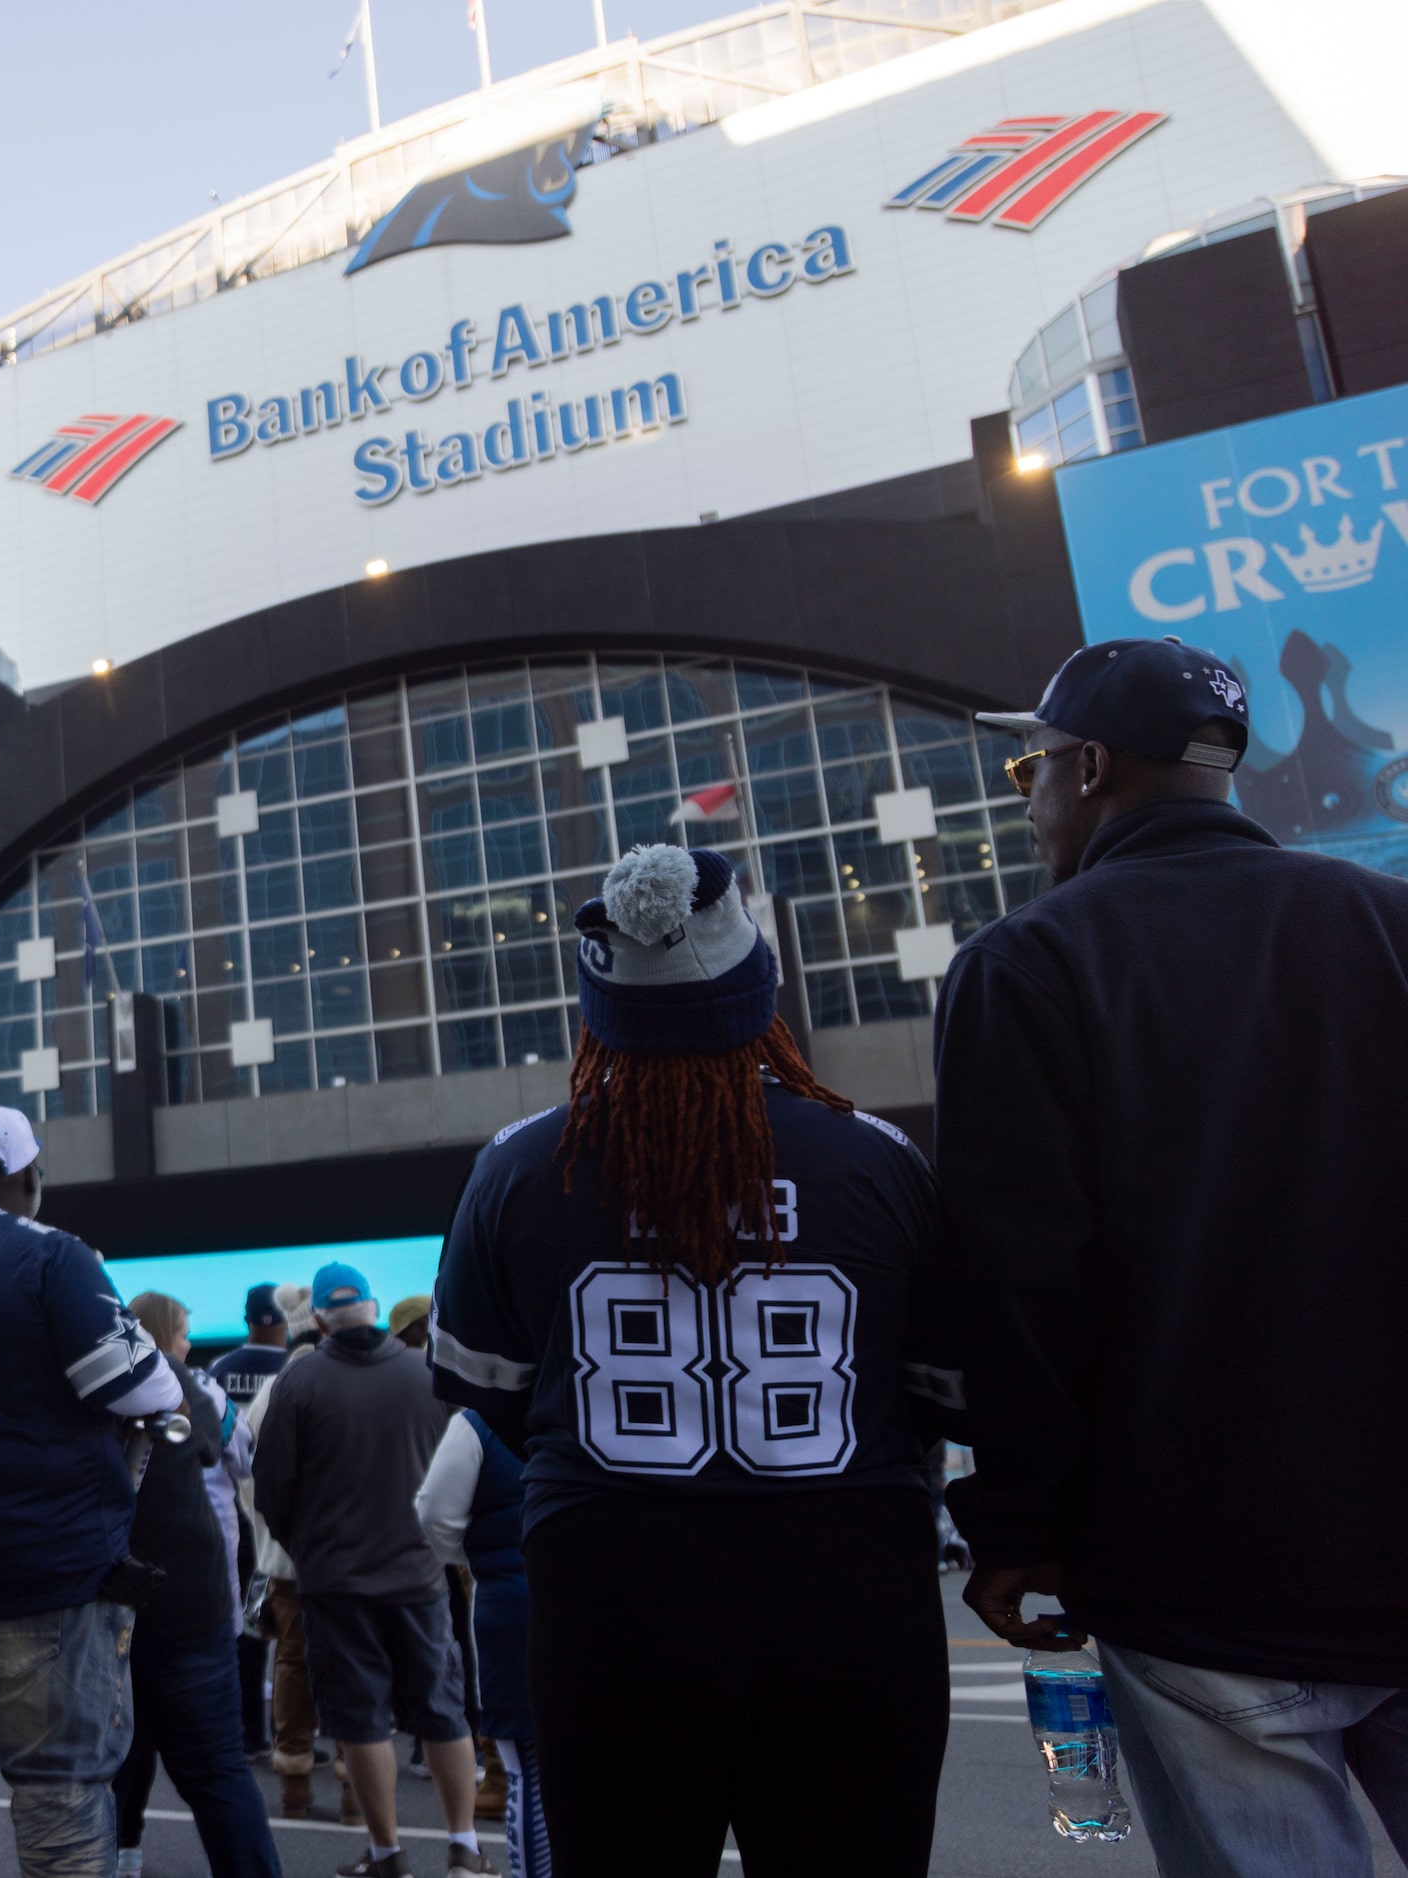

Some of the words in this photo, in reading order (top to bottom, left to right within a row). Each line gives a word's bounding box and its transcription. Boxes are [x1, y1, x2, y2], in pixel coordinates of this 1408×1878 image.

[206, 355, 390, 462] Bank
[400, 318, 477, 403] of
[492, 223, 858, 380] America
[353, 369, 689, 507] Stadium
[1200, 456, 1353, 530] FOR
[569, 1261, 858, 1478] 88
